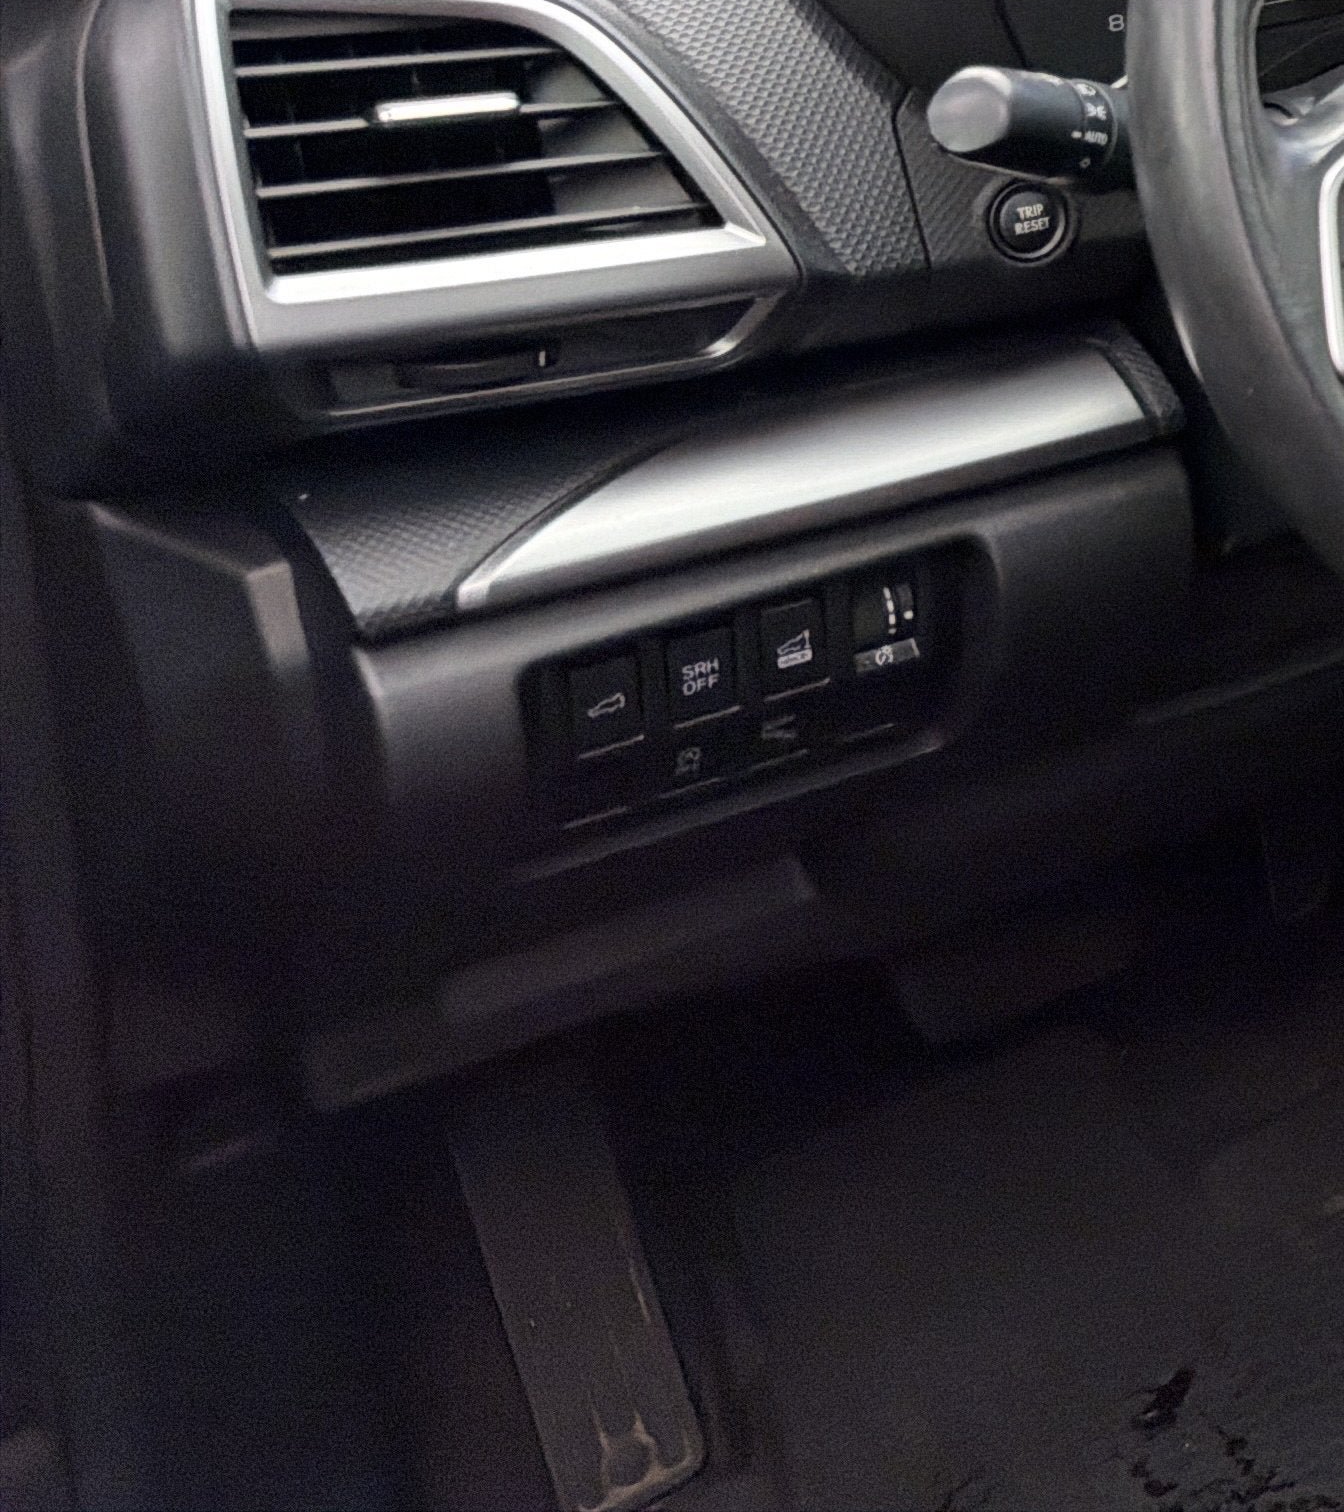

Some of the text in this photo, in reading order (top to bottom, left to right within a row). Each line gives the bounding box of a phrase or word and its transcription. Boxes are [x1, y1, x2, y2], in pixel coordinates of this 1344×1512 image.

[1108, 14, 1125, 32] 8
[1084, 131, 1108, 146] AUTO
[1017, 203, 1044, 221] TRIP
[1015, 216, 1050, 236] RESET
[682, 657, 719, 681] SRH
[682, 673, 720, 696] OFF
